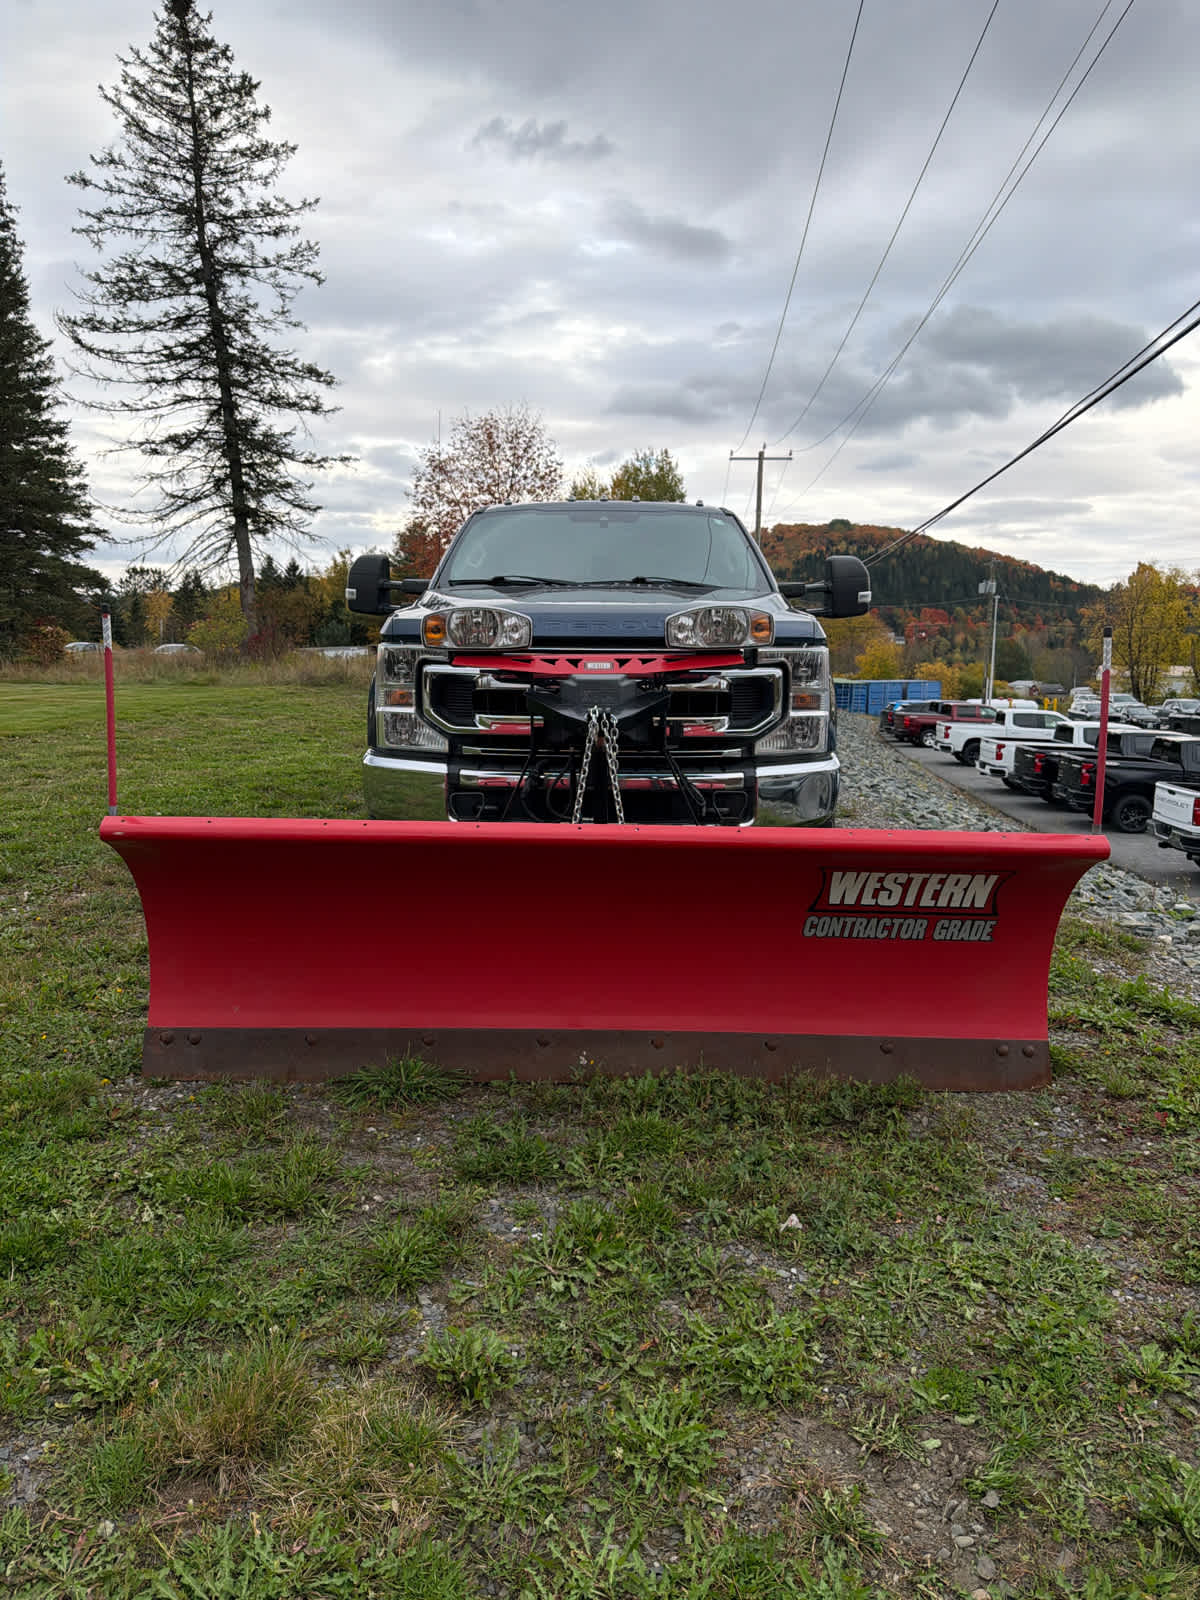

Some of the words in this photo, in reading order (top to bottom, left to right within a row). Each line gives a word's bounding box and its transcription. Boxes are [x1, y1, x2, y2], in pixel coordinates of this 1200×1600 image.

[829, 871, 998, 908] WESTERN
[804, 916, 928, 940] CONTRACTOR
[932, 919, 996, 941] GRADE
